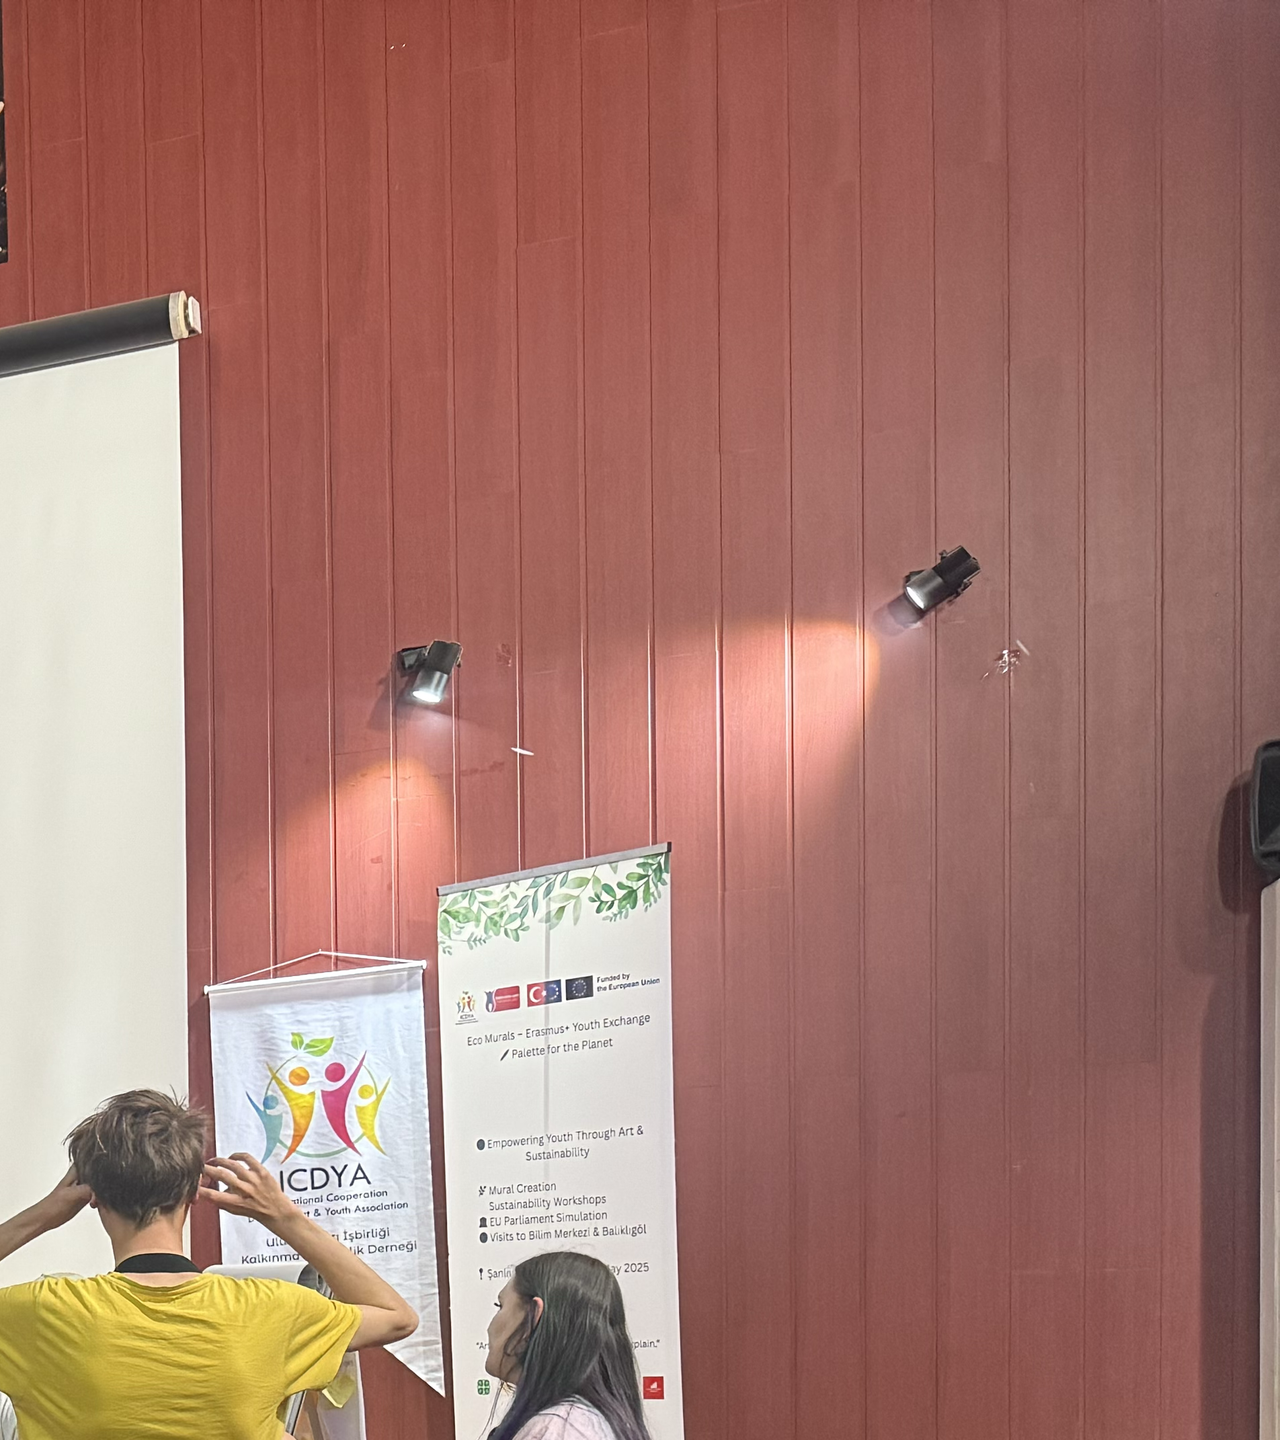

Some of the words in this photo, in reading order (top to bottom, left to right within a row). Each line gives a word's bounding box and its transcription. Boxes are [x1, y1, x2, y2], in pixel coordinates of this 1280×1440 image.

[597, 974, 620, 983] Funded
[609, 981, 639, 990] European
[641, 978, 660, 986] Union
[467, 1036, 483, 1046] Eco
[485, 1031, 515, 1044] Murals
[525, 1025, 570, 1039] Erasmus+
[573, 1021, 600, 1032] Youth
[603, 1014, 651, 1028] Exchange
[512, 1045, 545, 1059] Palette
[547, 1044, 560, 1054] for
[563, 1042, 579, 1052] the
[582, 1038, 613, 1050] Planet
[487, 1135, 544, 1150] Empowering
[546, 1132, 574, 1144] Youth
[576, 1128, 616, 1141] Through
[618, 1127, 634, 1137] Art
[636, 1125, 644, 1135] &
[525, 1147, 590, 1161] Sustainability
[279, 1163, 371, 1193] ICDYA
[326, 1190, 388, 1202] Cooperation
[489, 1184, 514, 1196] Mural
[516, 1182, 557, 1193] Creation
[313, 1208, 321, 1217] &
[325, 1206, 351, 1216] Youth
[354, 1201, 409, 1213] Association
[489, 1196, 551, 1211] Sustainability
[553, 1195, 607, 1207] Workshops
[490, 1217, 502, 1227] EU
[504, 1214, 554, 1226] Parliament
[556, 1210, 608, 1223] Simulation
[343, 1227, 390, 1242] İşbirliği
[490, 1232, 514, 1242] Visits
[516, 1231, 526, 1241] to
[528, 1229, 552, 1240] Bilim
[554, 1227, 591, 1239] Merkezi
[593, 1227, 600, 1236] &
[241, 1253, 300, 1265] Kalkınma
[368, 1240, 417, 1254] Derneği
[624, 1262, 649, 1273] 2025
